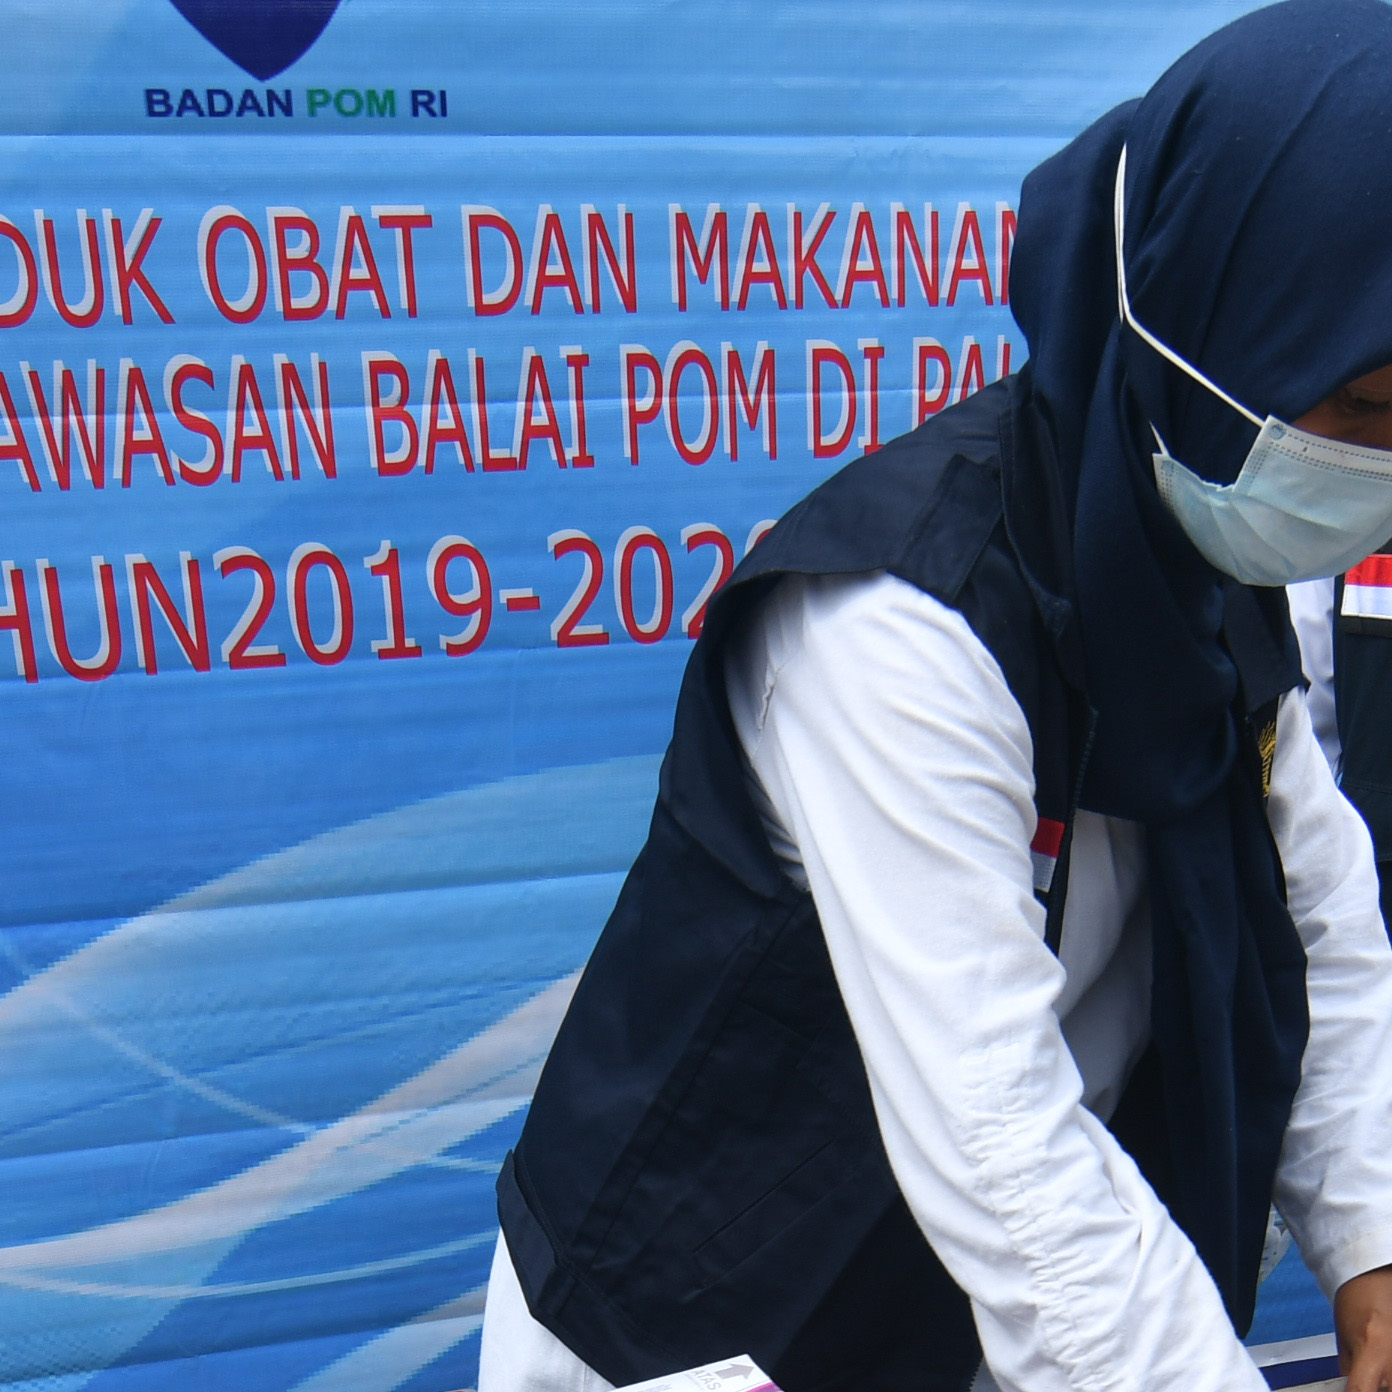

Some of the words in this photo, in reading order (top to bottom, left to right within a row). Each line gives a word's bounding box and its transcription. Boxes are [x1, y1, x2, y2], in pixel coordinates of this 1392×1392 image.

[144, 88, 294, 118] BADAN
[306, 88, 397, 118] POM
[410, 88, 449, 118] RI
[212, 208, 433, 326] OBAT
[466, 206, 637, 318] DAN
[368, 350, 596, 477] BALAI
[622, 346, 779, 466] POM
[809, 342, 884, 459] DI
